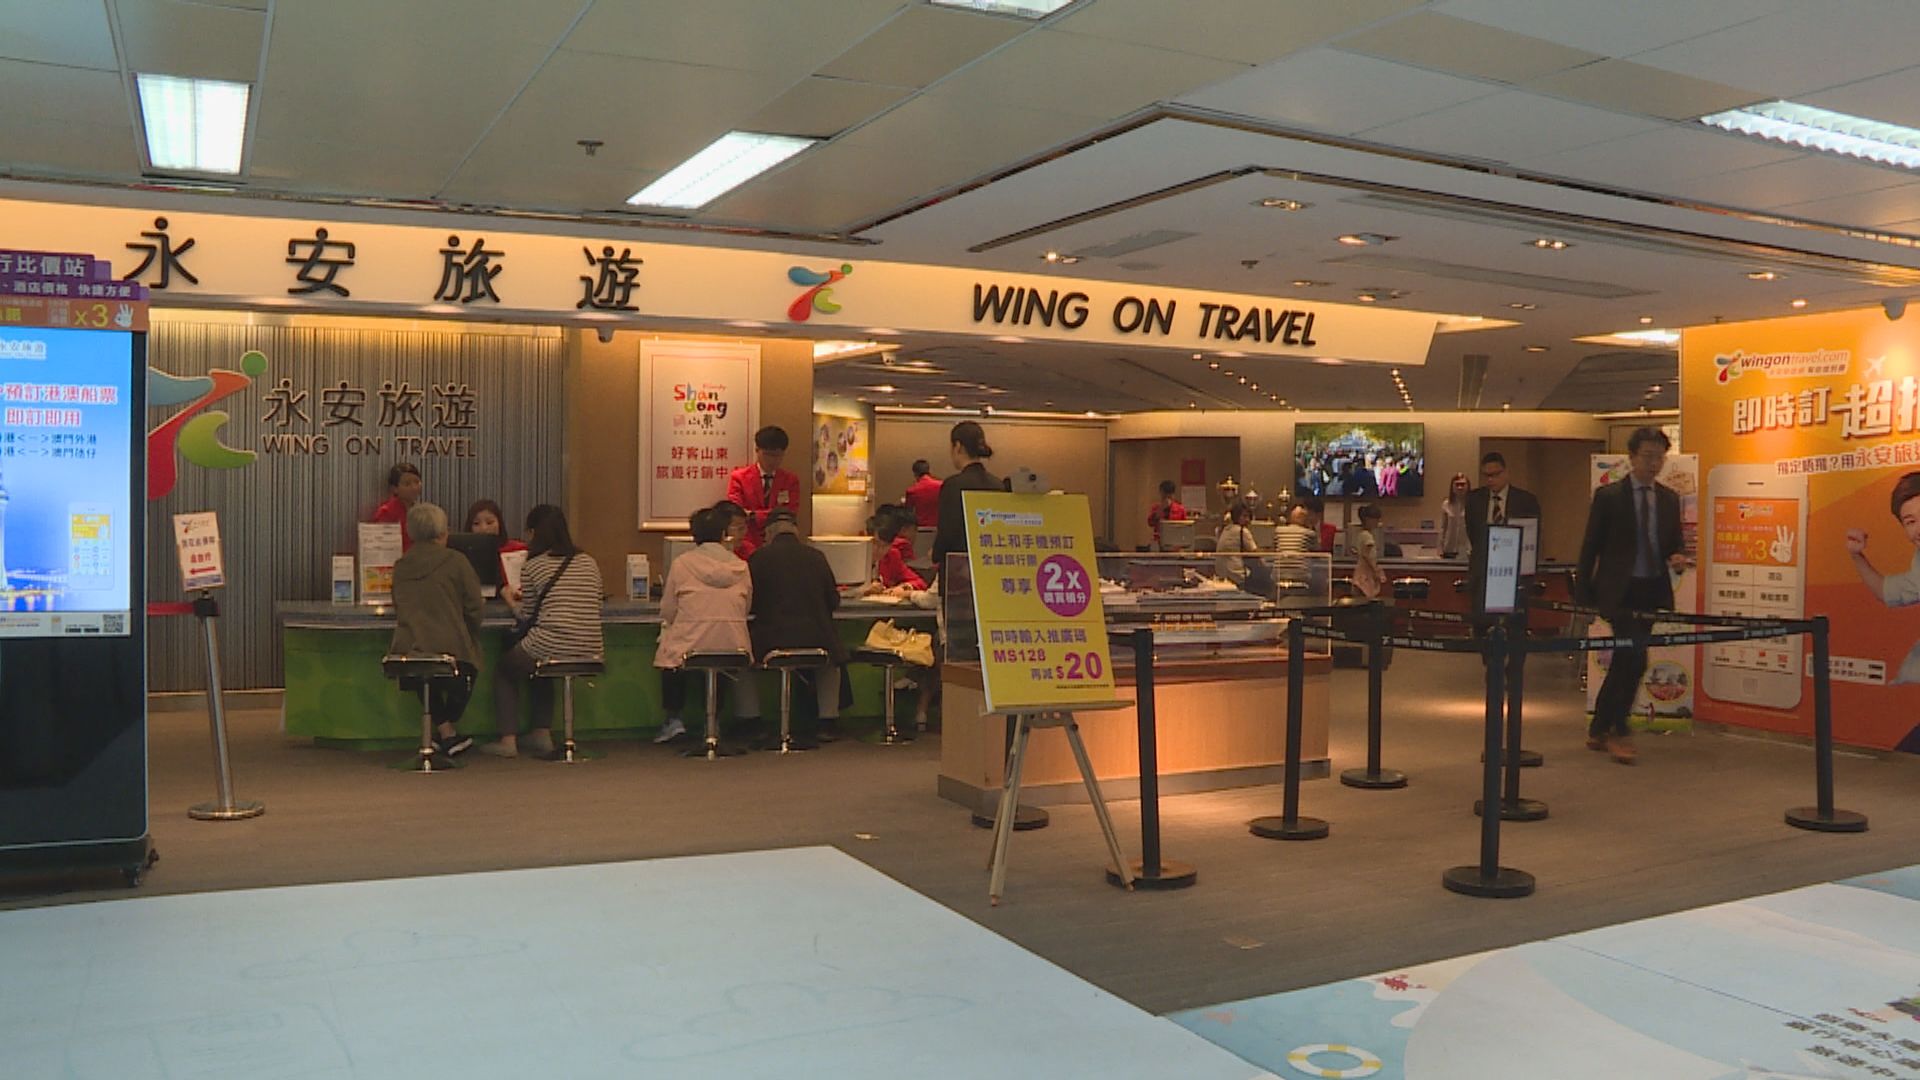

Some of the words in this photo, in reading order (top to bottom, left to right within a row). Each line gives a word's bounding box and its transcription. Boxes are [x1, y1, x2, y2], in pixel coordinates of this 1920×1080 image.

[123, 217, 643, 312] 永安旅遊
[973, 283, 1090, 329] WING
[1113, 296, 1176, 335] ON
[1199, 302, 1317, 346] TRAVEL
[674, 382, 719, 401] Shan
[263, 379, 476, 429] 永安旅遊
[684, 400, 728, 419] dong
[7, 408, 81, 425] 即訂即用
[262, 434, 330, 455] WING
[346, 436, 381, 455] ON
[395, 436, 476, 457] TRAVEL
[672, 446, 728, 459] 好客山東
[656, 465, 732, 480] 旅遊行銷中
[979, 534, 1075, 550] 網上和手機預訂
[990, 628, 1088, 643] 同時輸入推廣碼
[994, 650, 1046, 663] MS128
[1056, 652, 1103, 680] $20
